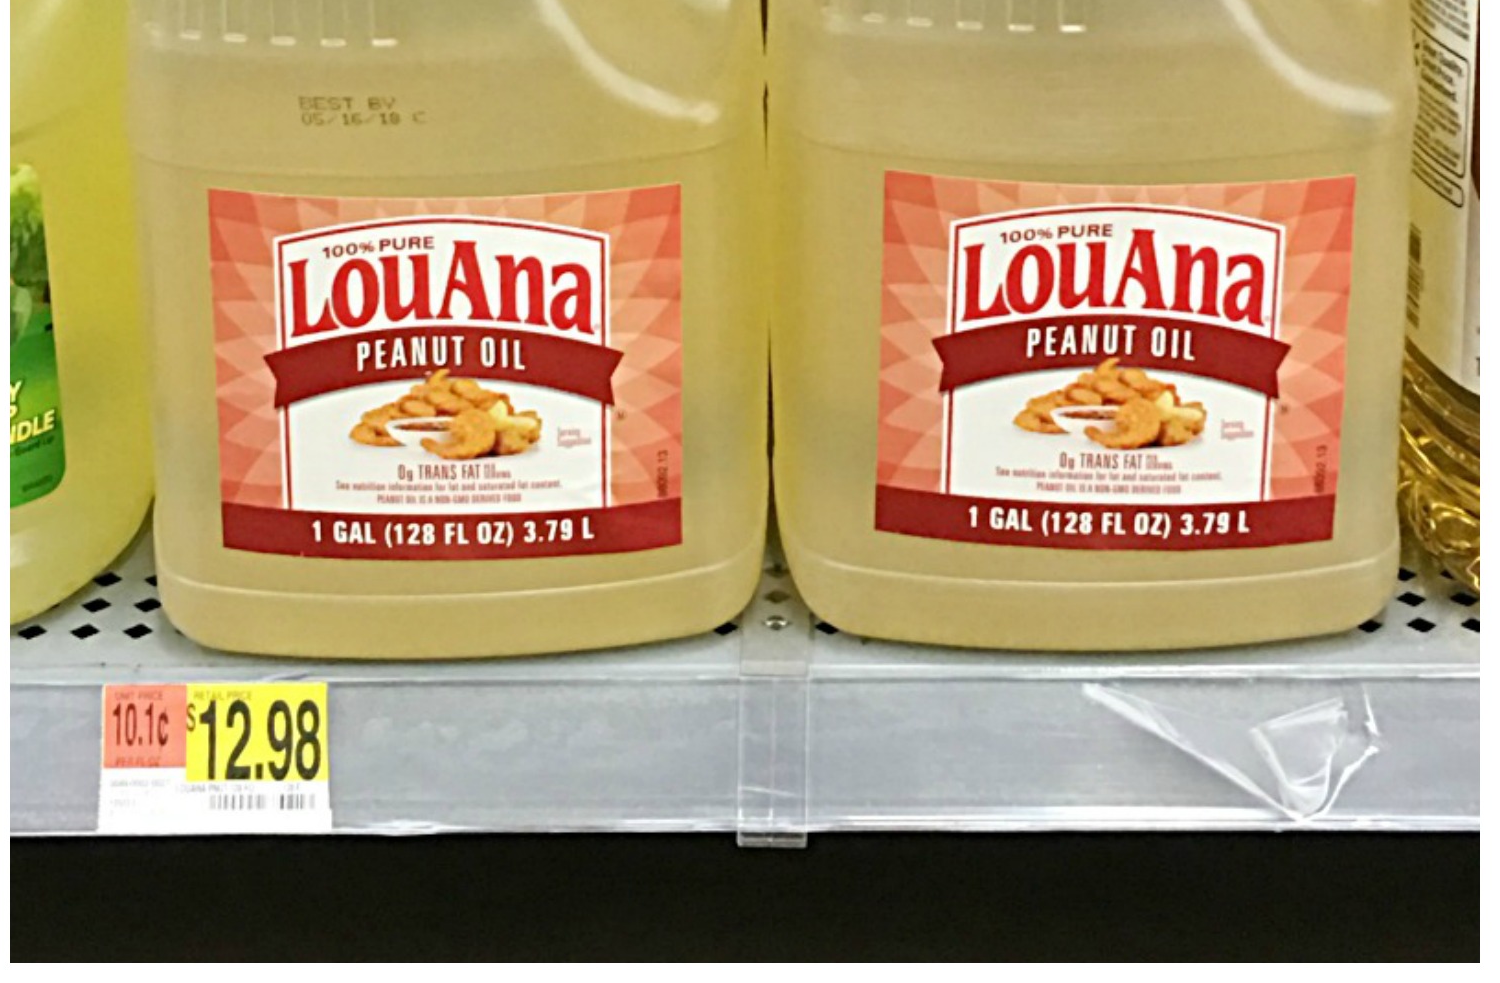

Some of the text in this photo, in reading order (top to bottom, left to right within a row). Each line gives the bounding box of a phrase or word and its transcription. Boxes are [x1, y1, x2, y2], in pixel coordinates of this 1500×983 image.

[299, 96, 396, 111] BEST BY
[412, 110, 427, 127] C
[1000, 223, 1113, 245] 100% PURE
[322, 236, 435, 260] 100% PURE
[288, 240, 596, 338] LouAna
[961, 228, 1266, 327] LouAna
[356, 335, 527, 372] PEANUT OIL
[1026, 325, 1196, 361] PEANUT OIL
[397, 464, 414, 481] 0g
[418, 464, 457, 481] TRANS
[461, 464, 481, 480] FAT
[1059, 452, 1075, 470] 0g
[1079, 452, 1119, 470] TRANS
[1123, 453, 1143, 470] FAT
[312, 516, 595, 548] 1 GAL (128 FL OZ) 3.79 L
[969, 505, 1250, 539] 1 GAL (128 FL OZ) 3.79 L
[226, 691, 252, 701] PRICE
